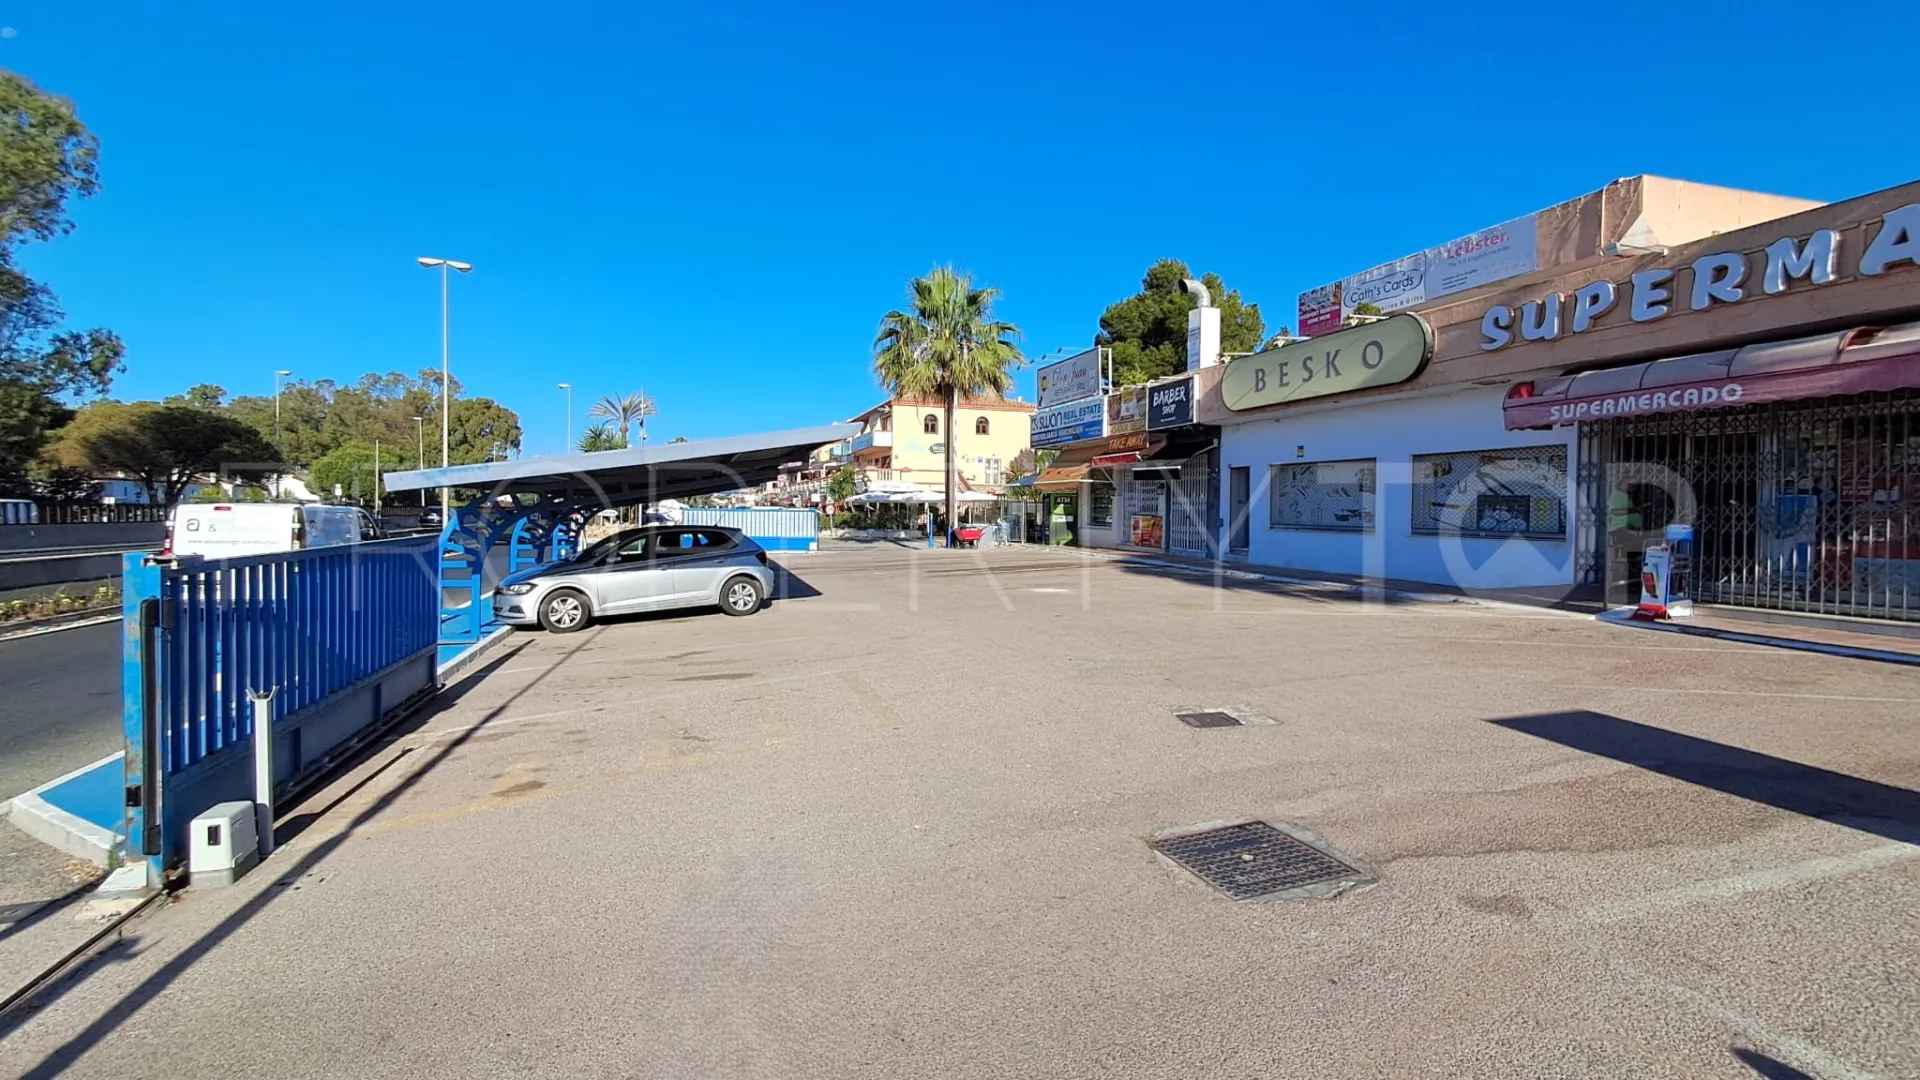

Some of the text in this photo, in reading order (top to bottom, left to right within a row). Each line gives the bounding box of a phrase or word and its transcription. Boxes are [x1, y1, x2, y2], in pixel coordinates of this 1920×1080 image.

[1480, 202, 1920, 351] SUPERMA
[1350, 275, 1414, 303] Cath's Cards
[1254, 340, 1384, 393] BESKO
[1153, 386, 1187, 407] BARBER
[1549, 383, 1744, 422] SUPERMERCADO
[1063, 408, 1077, 420] REAL
[1079, 403, 1102, 416] ESTATE
[1161, 403, 1177, 416] SHOP
[1109, 438, 1126, 451] TAKE
[1056, 496, 1071, 504] ATM
